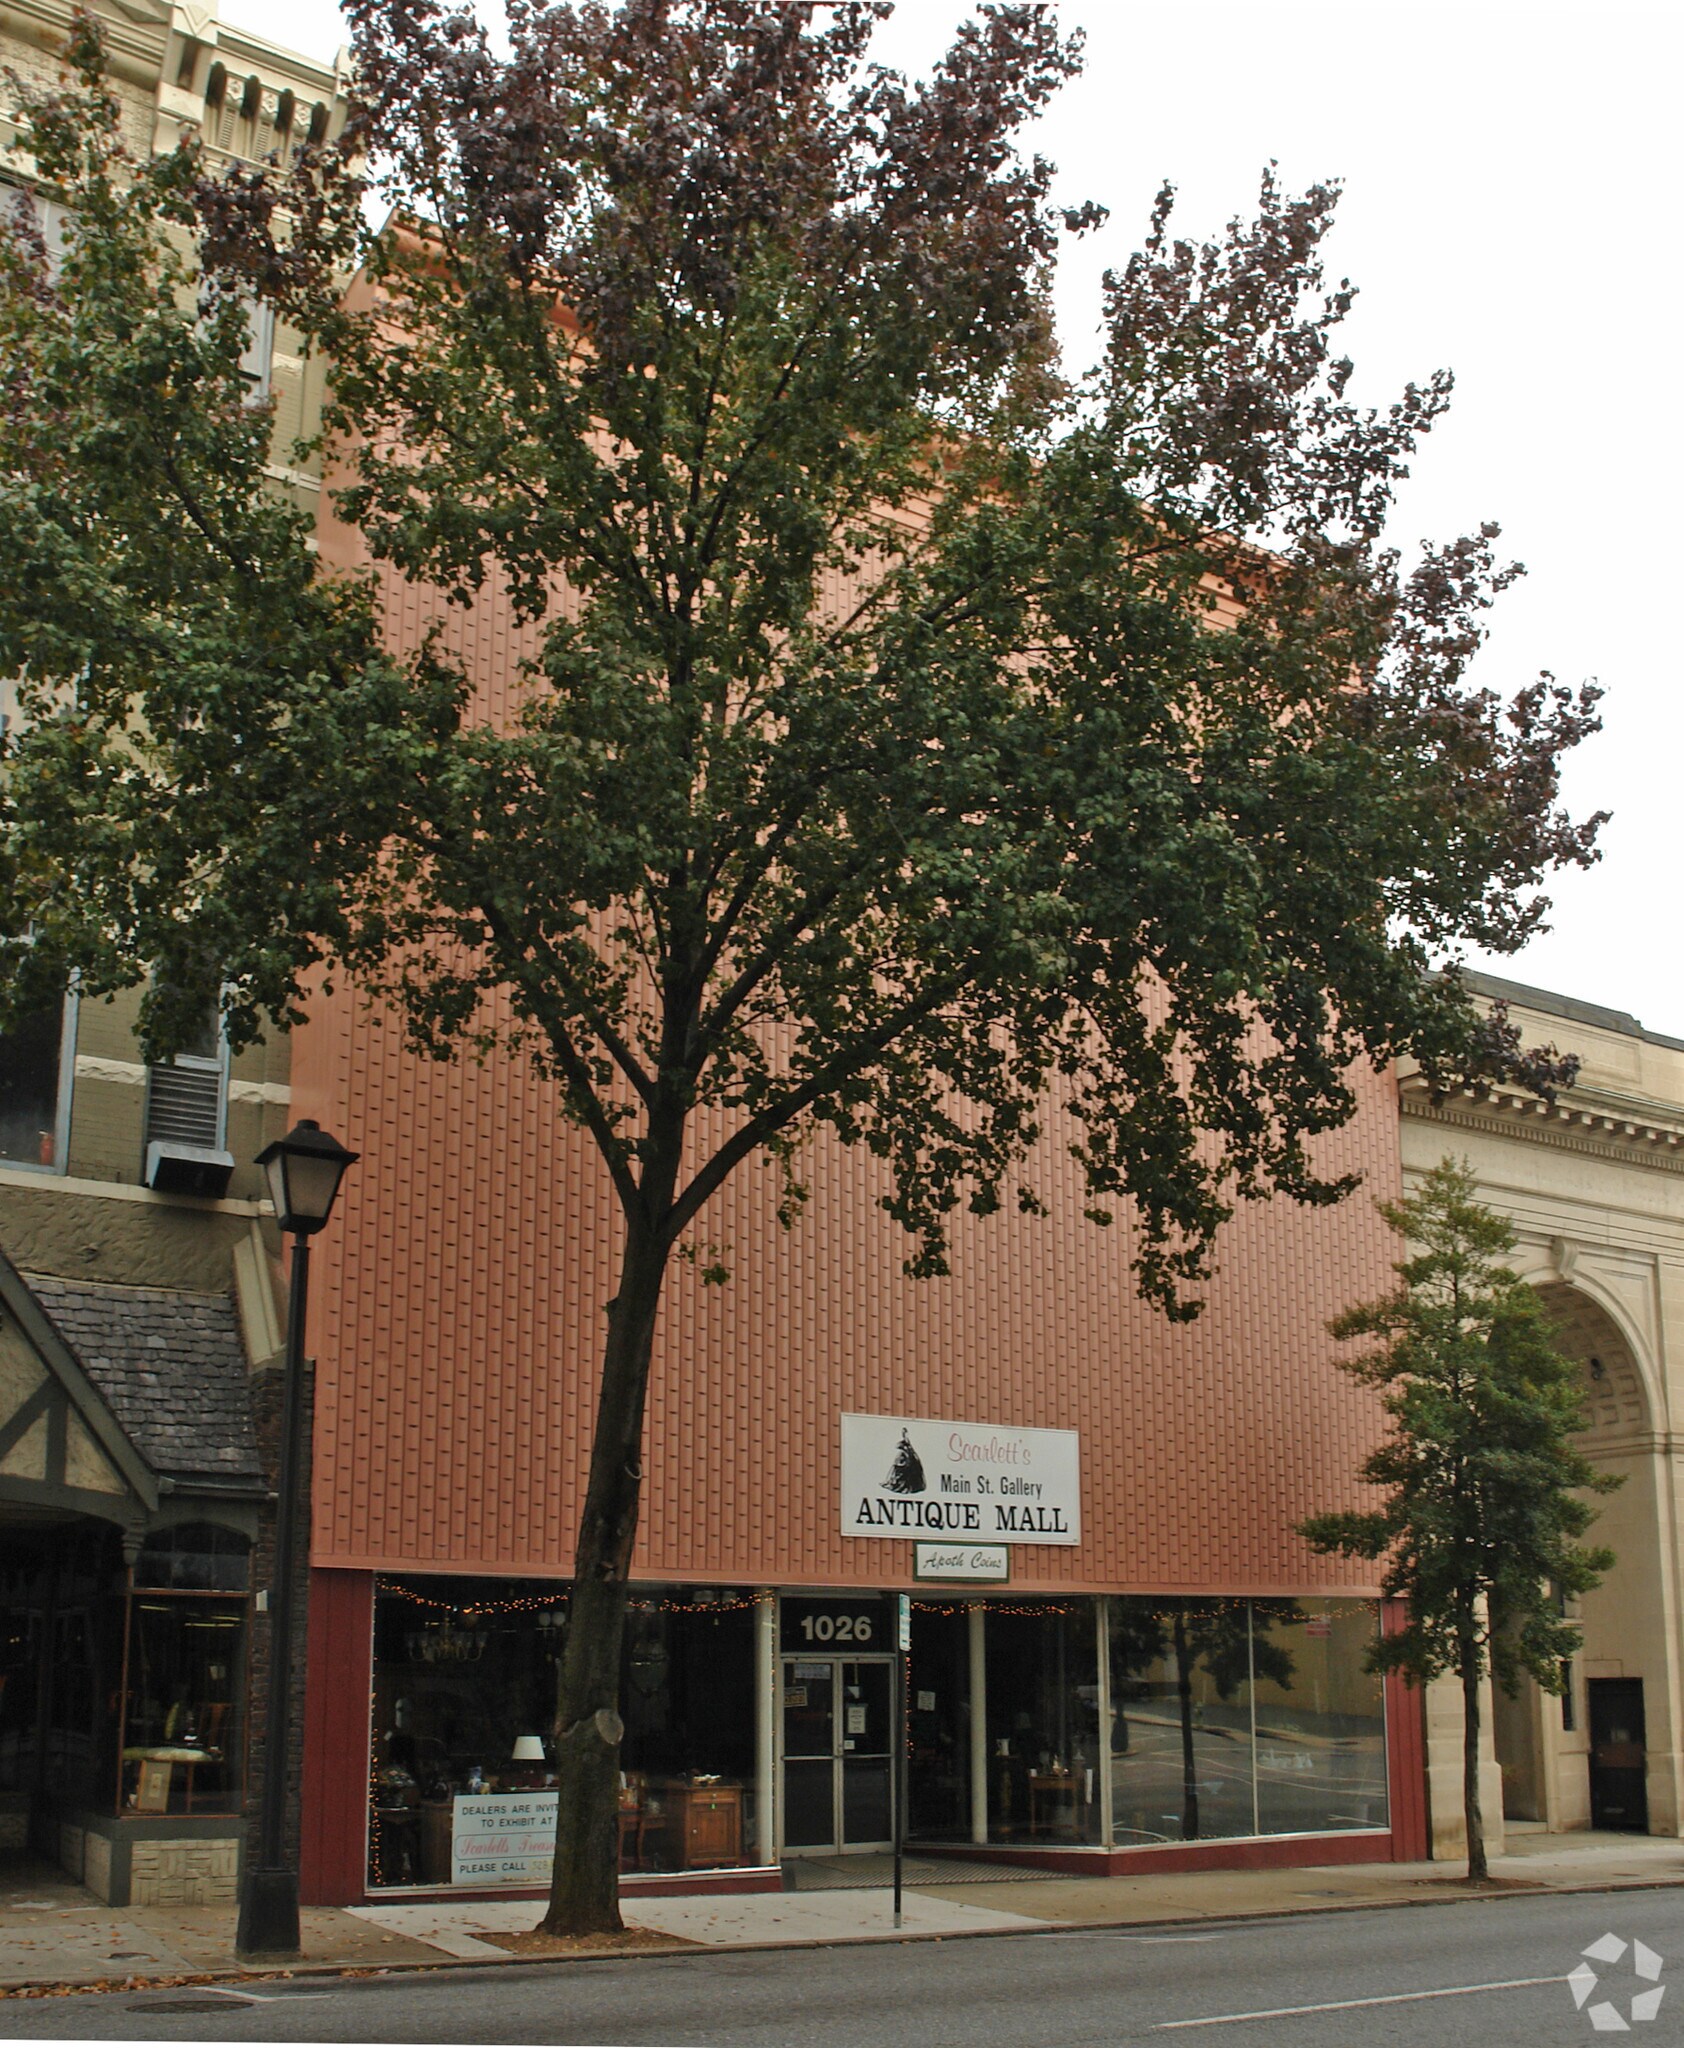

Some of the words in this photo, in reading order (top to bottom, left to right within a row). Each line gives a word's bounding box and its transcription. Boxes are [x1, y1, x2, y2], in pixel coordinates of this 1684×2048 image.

[946, 1432, 1032, 1466] Scarlett's
[940, 1474, 971, 1494] Main
[977, 1475, 995, 1495] St.
[1000, 1476, 1043, 1500] Gallery
[856, 1498, 980, 1530] ANTIQUE
[995, 1505, 1068, 1533] MALL
[801, 1615, 872, 1641] 1026
[462, 1805, 506, 1815] DEALERS
[512, 1804, 531, 1813] ARE
[536, 1803, 560, 1812] INVIT
[481, 1819, 494, 1828] TO
[499, 1817, 536, 1827] EXHIBIT
[540, 1817, 553, 1825] AT
[460, 1863, 496, 1874] PLEASE
[502, 1862, 526, 1871] CALL
